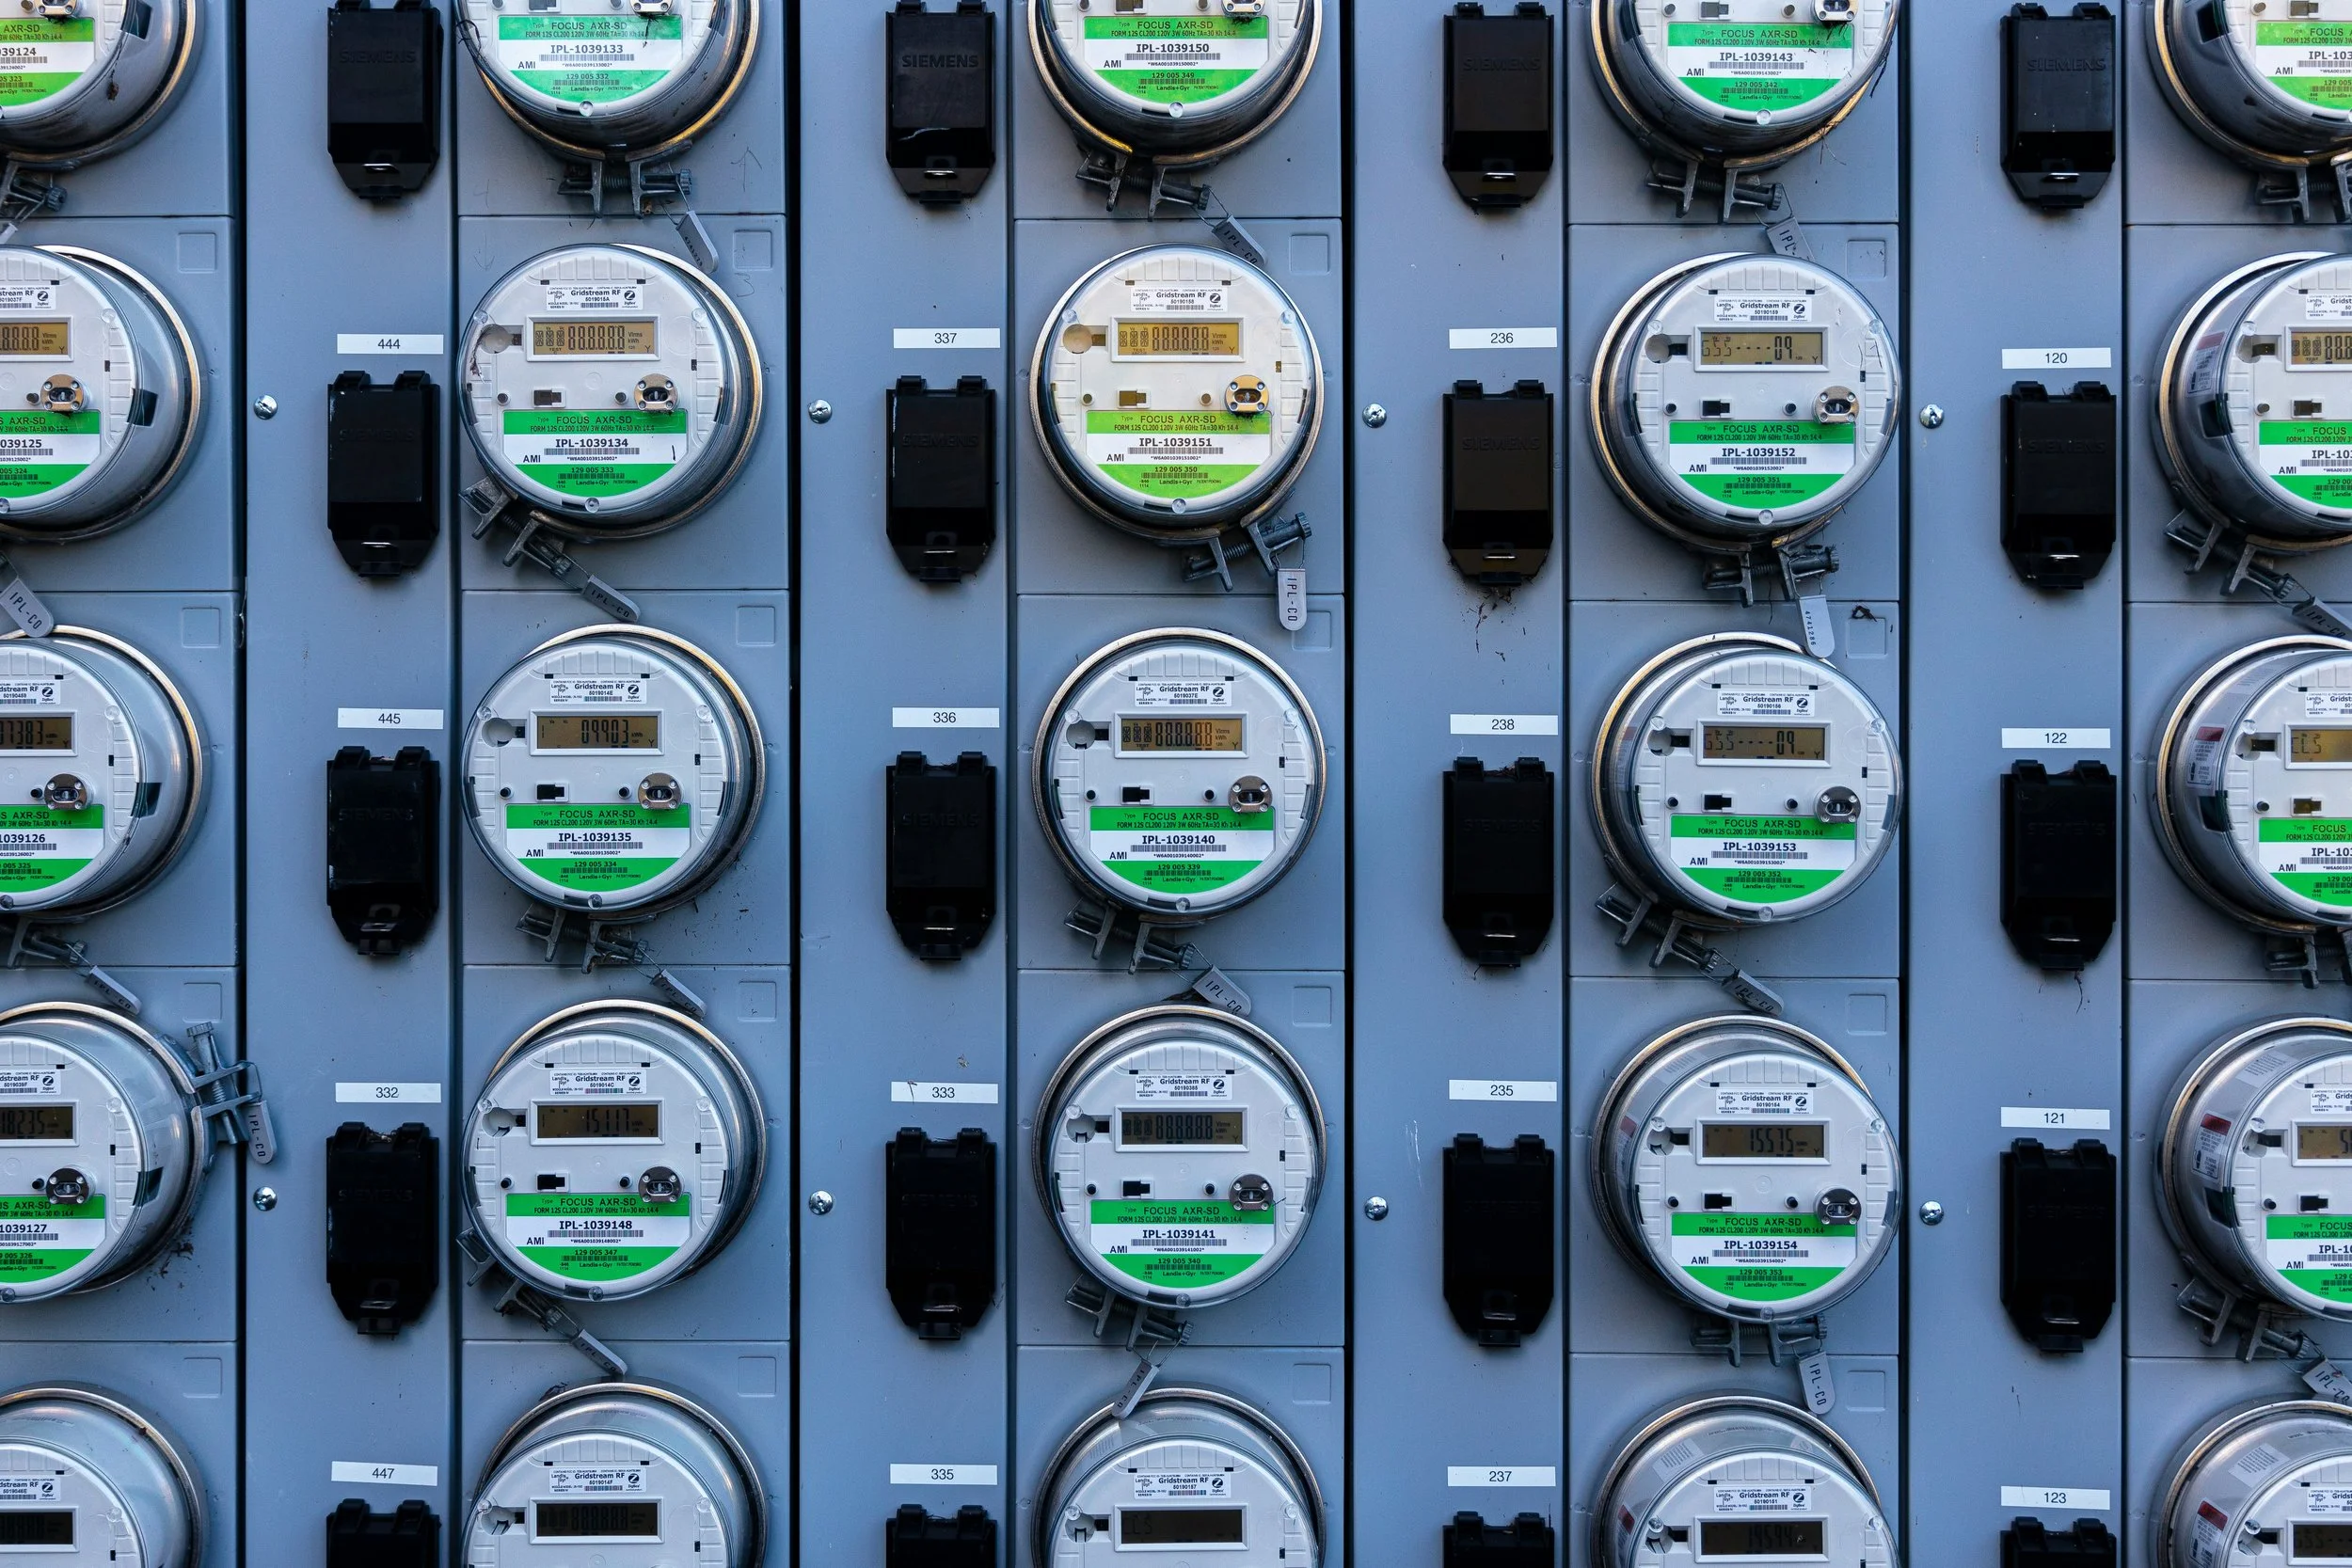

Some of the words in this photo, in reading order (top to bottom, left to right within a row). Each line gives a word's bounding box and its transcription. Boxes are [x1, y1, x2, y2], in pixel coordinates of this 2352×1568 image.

[3, 24, 40, 33] AXR-SD
[590, 22, 627, 30] AXR-SD
[1136, 21, 1171, 29] FOCUS
[1177, 21, 1214, 29] AXR-SD
[1721, 29, 1755, 38] FOCUS
[1760, 29, 1798, 39] AXR-SD
[2310, 28, 2344, 37] FOCUS
[551, 44, 623, 54] IPL-1039133
[1136, 43, 1210, 53] IPL-1039150
[902, 55, 979, 68] SIEMENS
[1720, 52, 1793, 62] IPL-1039143
[518, 60, 537, 69] AMI
[1104, 59, 1121, 69] AMI
[2026, 58, 2106, 71] SIEMENS
[1686, 67, 1705, 76] AMI
[2275, 67, 2294, 75] AMI
[1223, 230, 1258, 265] IPL-CO
[1155, 291, 1196, 299] Gridstream
[1740, 301, 1780, 309] Gridstream
[934, 332, 958, 344] 337
[1490, 332, 1514, 344] 236
[377, 339, 401, 350] 444
[2045, 352, 2068, 364] 120
[9, 417, 46, 425] AXR-SD
[596, 416, 632, 424] AXR-SD
[1180, 416, 1216, 424] AXR-SD
[1723, 425, 1757, 434] FOCUS
[1763, 425, 1800, 434] AXR-SD
[2312, 427, 2346, 436] FOCUS
[555, 438, 628, 448] IPL-1039134
[1139, 438, 1213, 448] IPL-1039151
[1106, 453, 1125, 463] AMI
[1722, 448, 1796, 458] IPL-1039152
[522, 454, 541, 463] AMI
[1688, 465, 1707, 473] AMI
[590, 589, 630, 618] IPL-CO
[1286, 577, 1298, 623] IPL-CO
[8, 591, 42, 629] IPL-CO
[1742, 695, 1783, 704] Gridstream
[377, 712, 401, 725] 445
[932, 711, 957, 723] 336
[1491, 718, 1515, 731] 238
[2044, 732, 2067, 744] 122
[1143, 813, 1177, 821] FOCUS
[1183, 813, 1219, 821] AXR-SD
[1724, 819, 1758, 829] FOCUS
[1764, 820, 1802, 829] AXR-SD
[2312, 824, 2346, 833] FOCUS
[558, 833, 632, 842] IPL-1039135
[1142, 835, 1216, 845] IPL-1039140
[525, 848, 544, 857] AMI
[1723, 842, 1797, 853] IPL-1039153
[1109, 851, 1128, 860] AMI
[1689, 858, 1708, 866] AMI
[2278, 863, 2296, 872] AMI
[1206, 980, 1242, 1012] IPL-CO
[375, 1086, 399, 1099] 332
[931, 1086, 956, 1099] 333
[1490, 1084, 1514, 1097] 235
[1741, 1094, 1782, 1102] Gridstream
[2043, 1112, 2064, 1124] 121
[247, 1115, 266, 1158] IPL-CO
[14, 1201, 52, 1210] AXR-SD
[560, 1198, 595, 1207] FOCUS
[600, 1198, 638, 1207] AXR-SD
[559, 1221, 633, 1230] IPL-1039148
[1724, 1218, 1759, 1227] FOCUS
[1765, 1218, 1802, 1227] AXR-SD
[1142, 1229, 1216, 1239] IPL-1039141
[525, 1237, 544, 1245] AMI
[1724, 1241, 1798, 1251] IPL-1039154
[1109, 1244, 1128, 1254] AMI
[1690, 1257, 1708, 1265] AMI
[1808, 1362, 1827, 1406] IPL-CO
[372, 1467, 395, 1480] 447
[930, 1468, 955, 1481] 335
[1488, 1470, 1513, 1482] 237
[2043, 1492, 2067, 1504] 123
